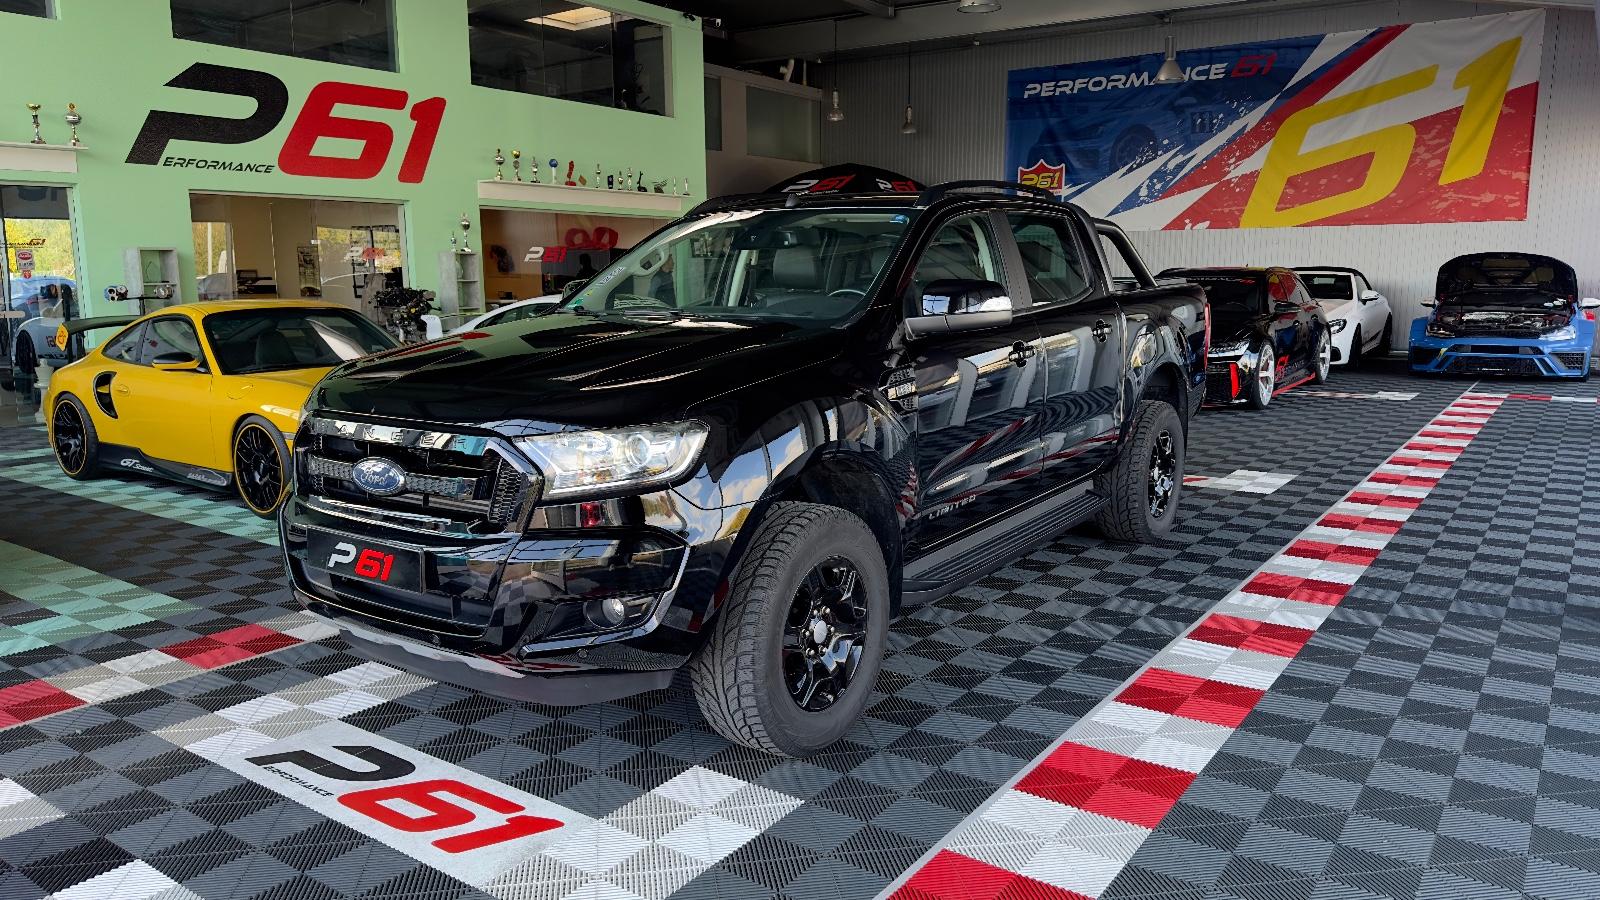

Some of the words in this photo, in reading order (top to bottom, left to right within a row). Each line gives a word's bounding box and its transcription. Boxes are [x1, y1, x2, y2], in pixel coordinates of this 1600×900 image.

[1231, 53, 1278, 79] 61
[1239, 36, 1523, 229] 61
[315, 420, 468, 451] RANGER
[120, 458, 140, 468] GT
[360, 468, 389, 486] Ford
[928, 494, 976, 520] LIMITED
[327, 541, 395, 582] P61
